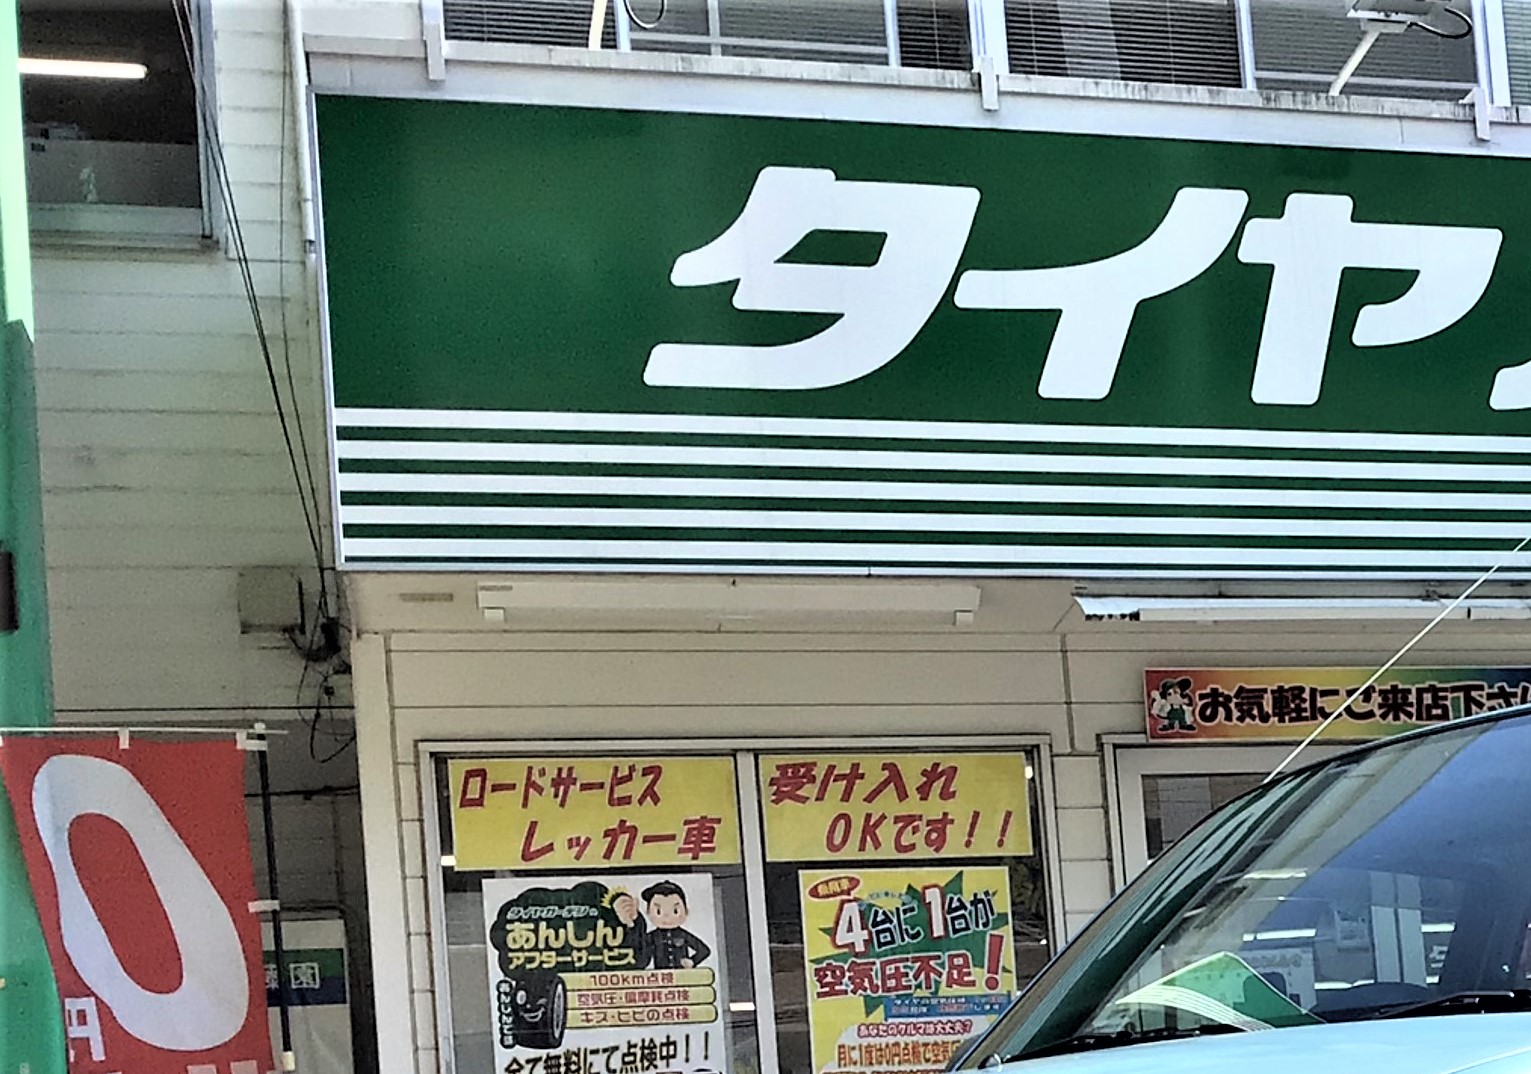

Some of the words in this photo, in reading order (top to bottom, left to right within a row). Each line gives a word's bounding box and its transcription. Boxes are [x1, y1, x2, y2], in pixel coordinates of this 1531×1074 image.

[458, 764, 663, 810] ロードサービス
[768, 761, 958, 805] 受け入れ
[521, 815, 722, 863] レッカー車
[505, 919, 625, 950] あんしん
[831, 882, 996, 955] 4台に1台が
[507, 948, 637, 970] アフターサービス
[590, 972, 674, 987] 100km点検
